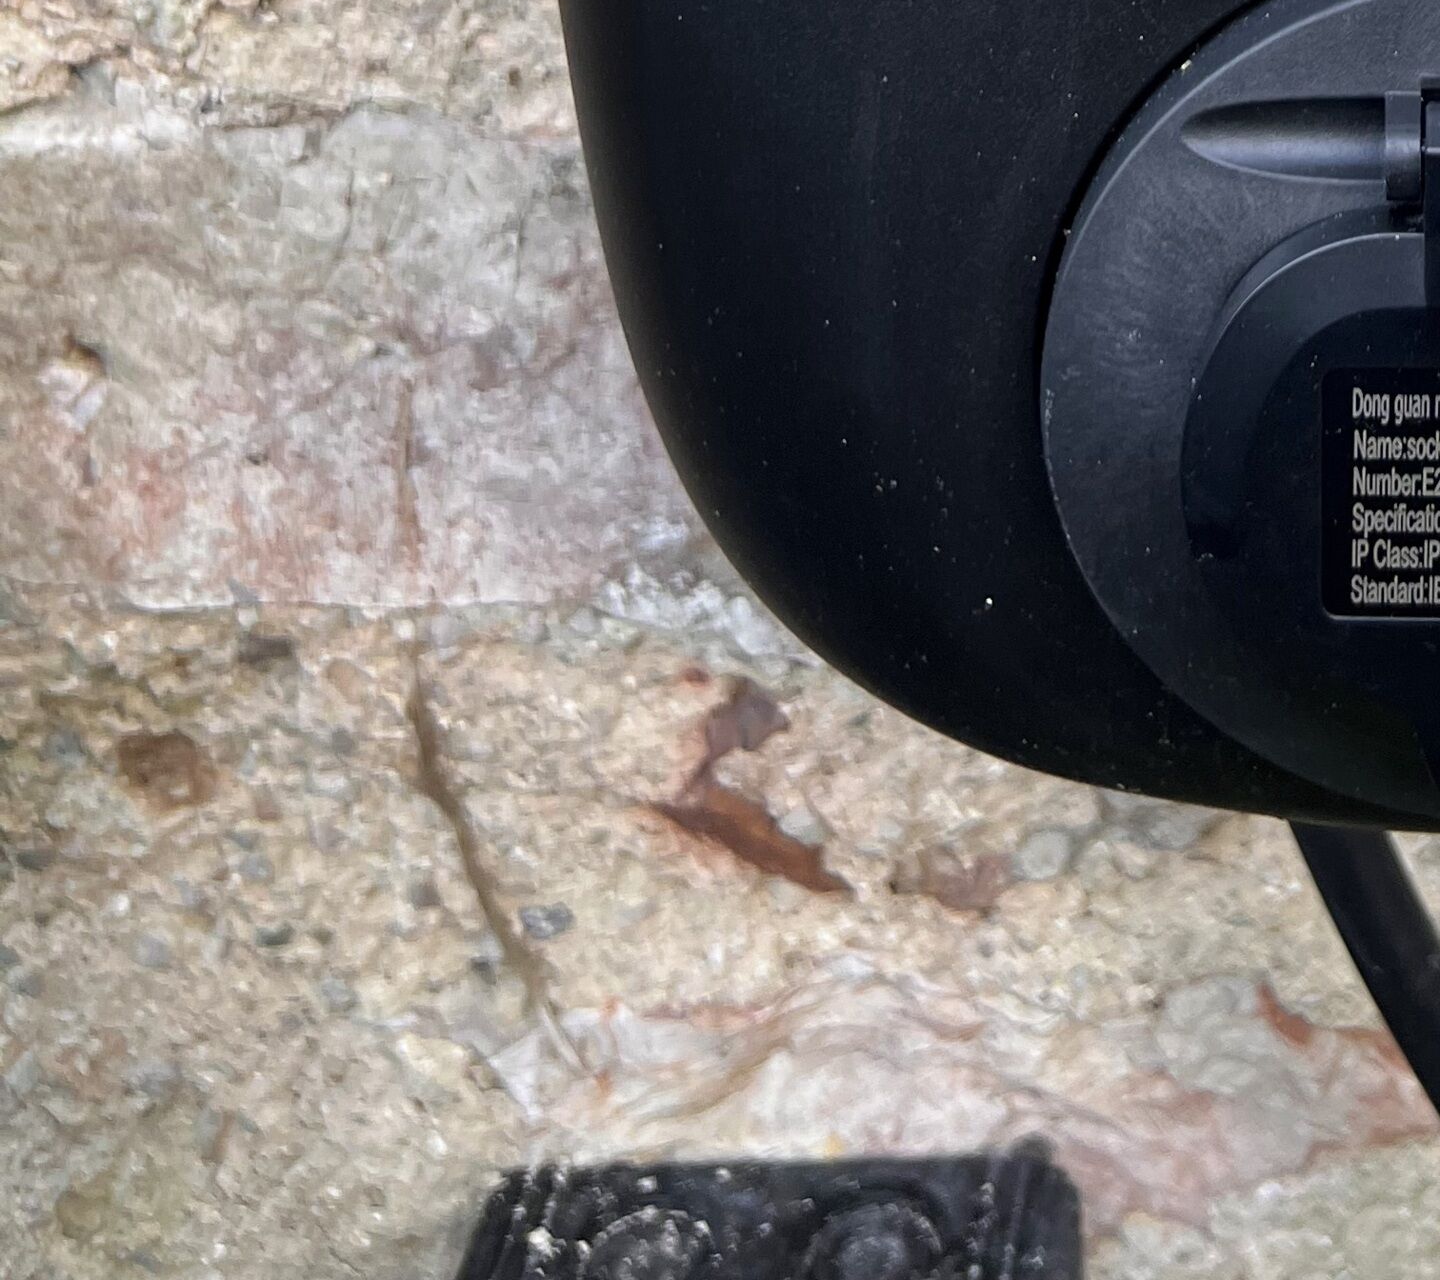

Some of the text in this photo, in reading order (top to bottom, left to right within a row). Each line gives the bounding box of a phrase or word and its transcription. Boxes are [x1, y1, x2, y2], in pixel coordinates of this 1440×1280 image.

[1352, 387, 1389, 424] Dong
[1394, 394, 1430, 425] guan
[1351, 540, 1370, 569] IP
